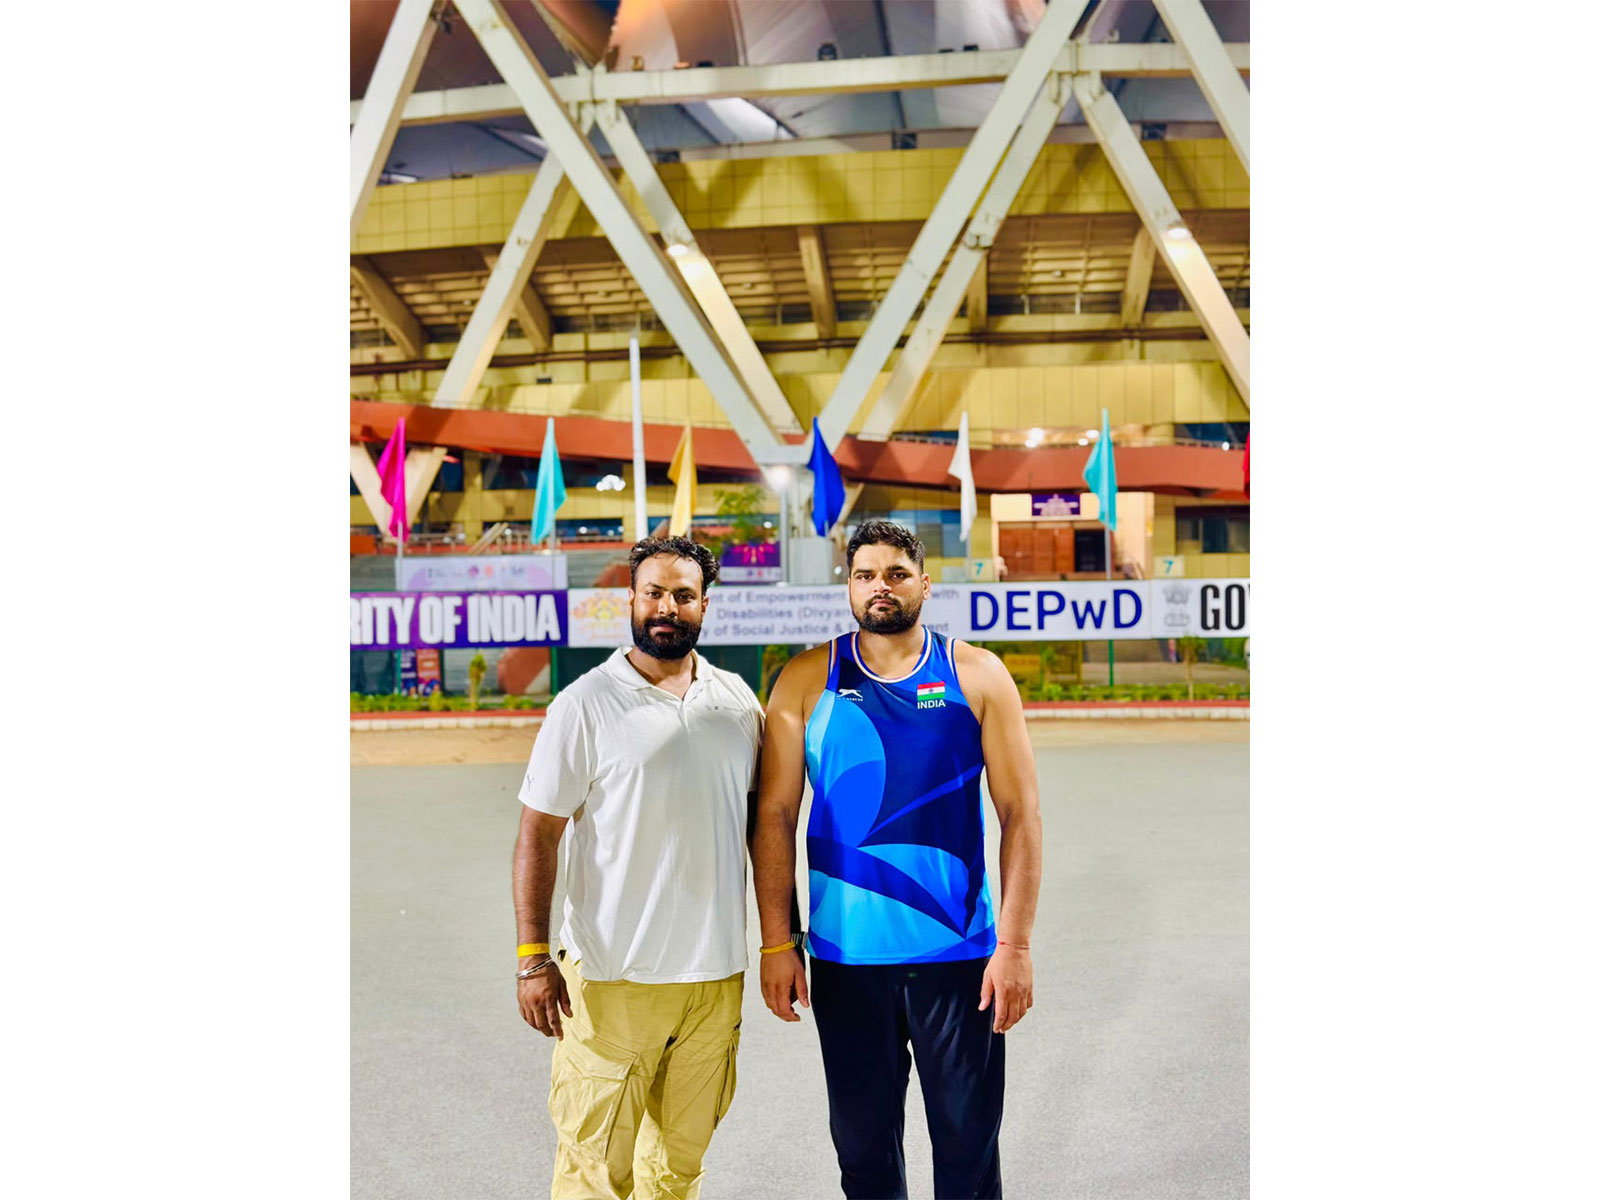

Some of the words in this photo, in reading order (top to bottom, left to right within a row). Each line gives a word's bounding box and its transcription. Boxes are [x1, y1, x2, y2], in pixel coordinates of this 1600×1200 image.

[974, 562, 983, 576] 7
[1163, 560, 1174, 573] 7
[728, 592, 742, 603] of
[746, 591, 846, 605] Empowerment
[931, 589, 960, 600] with
[716, 608, 793, 620] Disabilities
[970, 588, 1143, 631] DEPwD
[1201, 584, 1250, 631] GO
[419, 595, 462, 645] OF
[467, 594, 562, 643] INDIA
[713, 625, 728, 636] of
[733, 623, 775, 636] Social
[780, 623, 829, 636] Justice
[834, 622, 843, 633] &
[917, 699, 946, 709] INDIA
